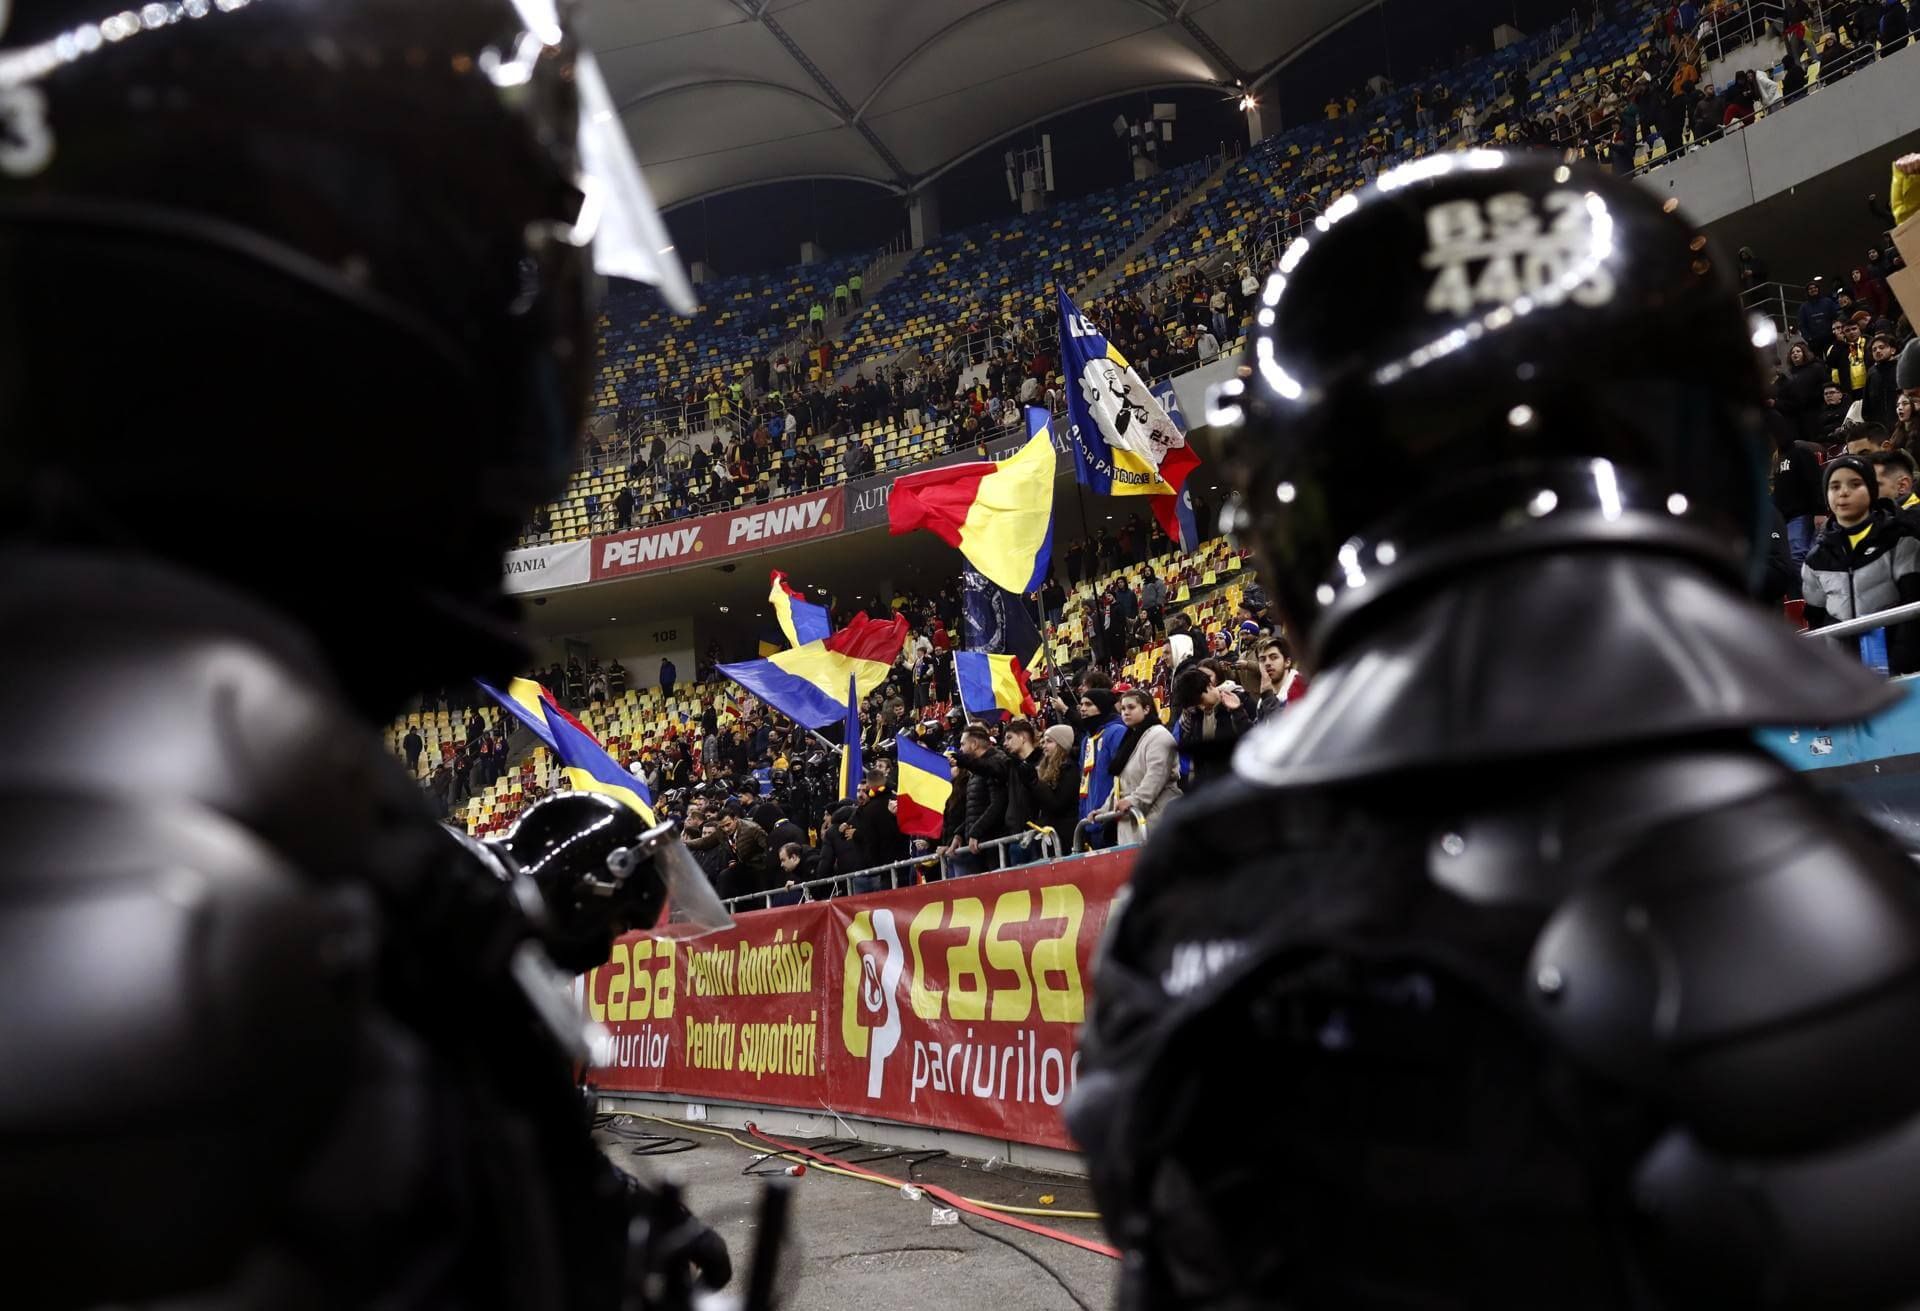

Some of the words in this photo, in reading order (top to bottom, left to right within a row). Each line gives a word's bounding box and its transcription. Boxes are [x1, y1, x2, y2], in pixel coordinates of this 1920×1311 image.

[685, 943, 735, 997] Pentru
[738, 928, 814, 996] România
[685, 1014, 737, 1071] Pentru
[738, 1010, 817, 1081] suporteri
